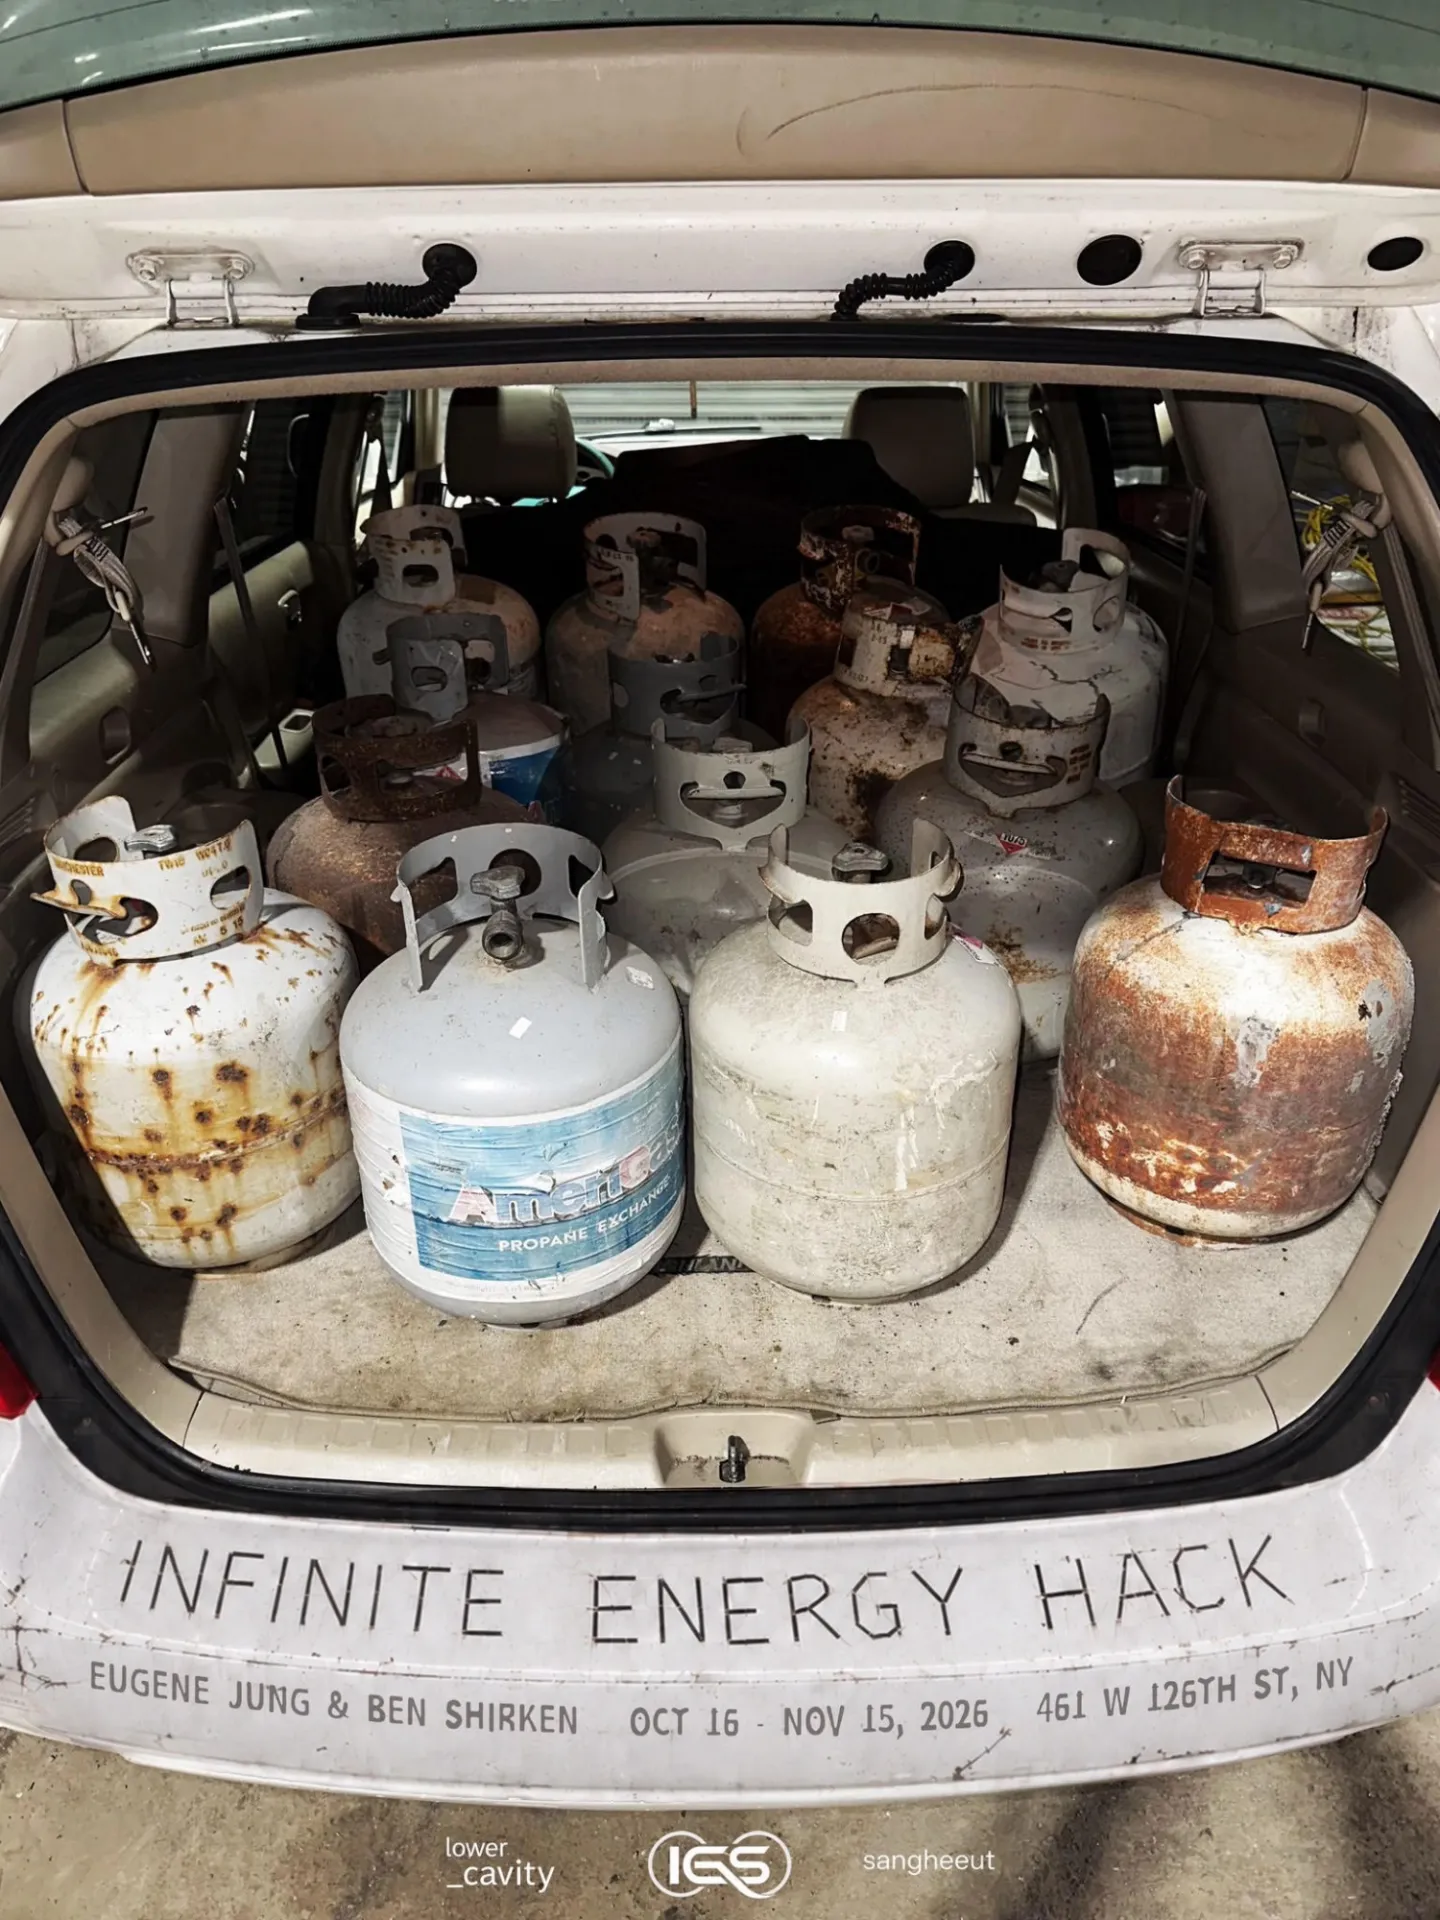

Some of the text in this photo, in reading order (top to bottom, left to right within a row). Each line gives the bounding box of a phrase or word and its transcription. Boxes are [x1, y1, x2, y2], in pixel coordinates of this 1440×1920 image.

[498, 1174, 673, 1252] PROPANE EXCHANGE
[120, 1534, 1295, 1645] INFINITE ENERGY HACK
[90, 1661, 577, 1735] EUGENE JUNG & BEN SHIRKEN
[630, 1706, 690, 1737] OCT
[706, 1707, 739, 1737] 16
[783, 1705, 845, 1737] NOV
[862, 1704, 904, 1740] 15,
[920, 1699, 989, 1732] 2026
[1036, 1656, 1354, 1723] 461 W 126TH ST, NY
